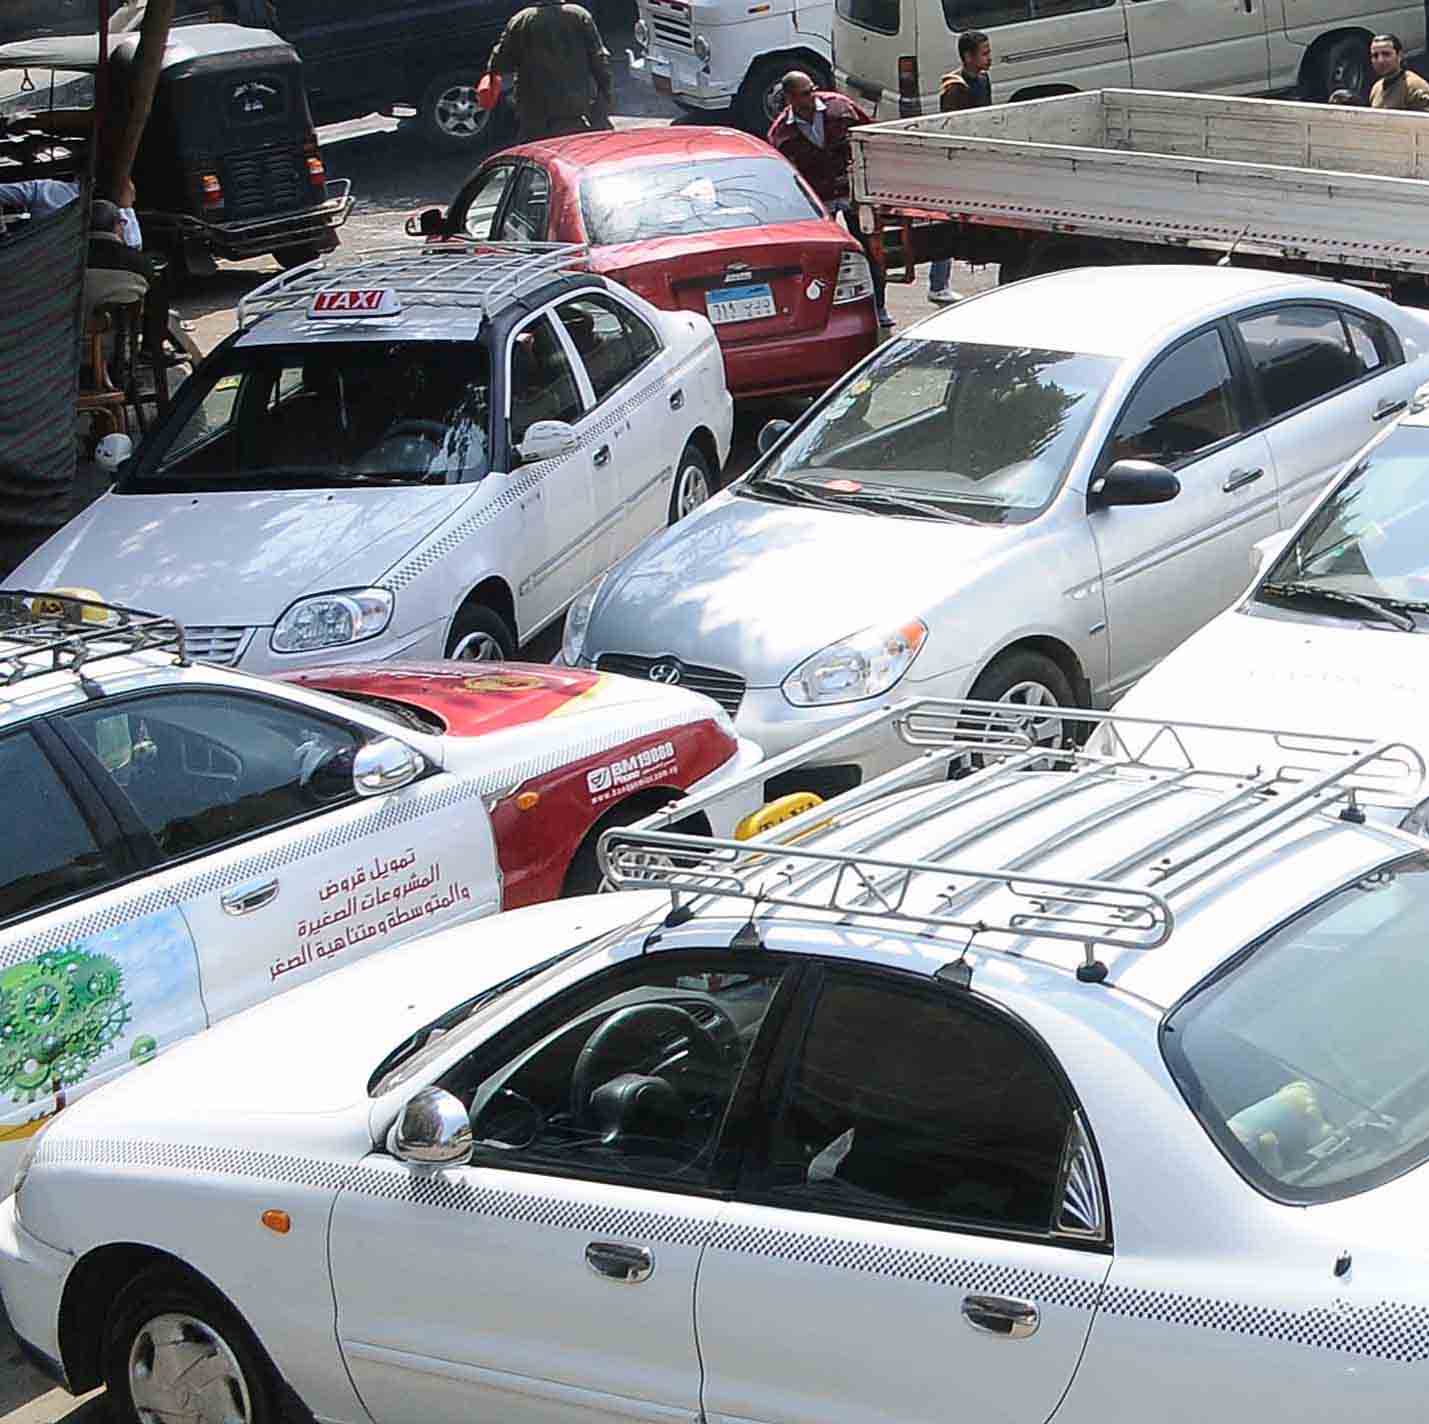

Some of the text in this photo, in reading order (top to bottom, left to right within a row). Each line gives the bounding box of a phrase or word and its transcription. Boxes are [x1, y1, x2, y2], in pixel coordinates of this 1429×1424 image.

[319, 290, 382, 310] TAXI
[318, 847, 417, 901] تمويل قروض
[297, 863, 440, 937] المشروعات الصغيرة
[269, 948, 313, 982] الصغر
